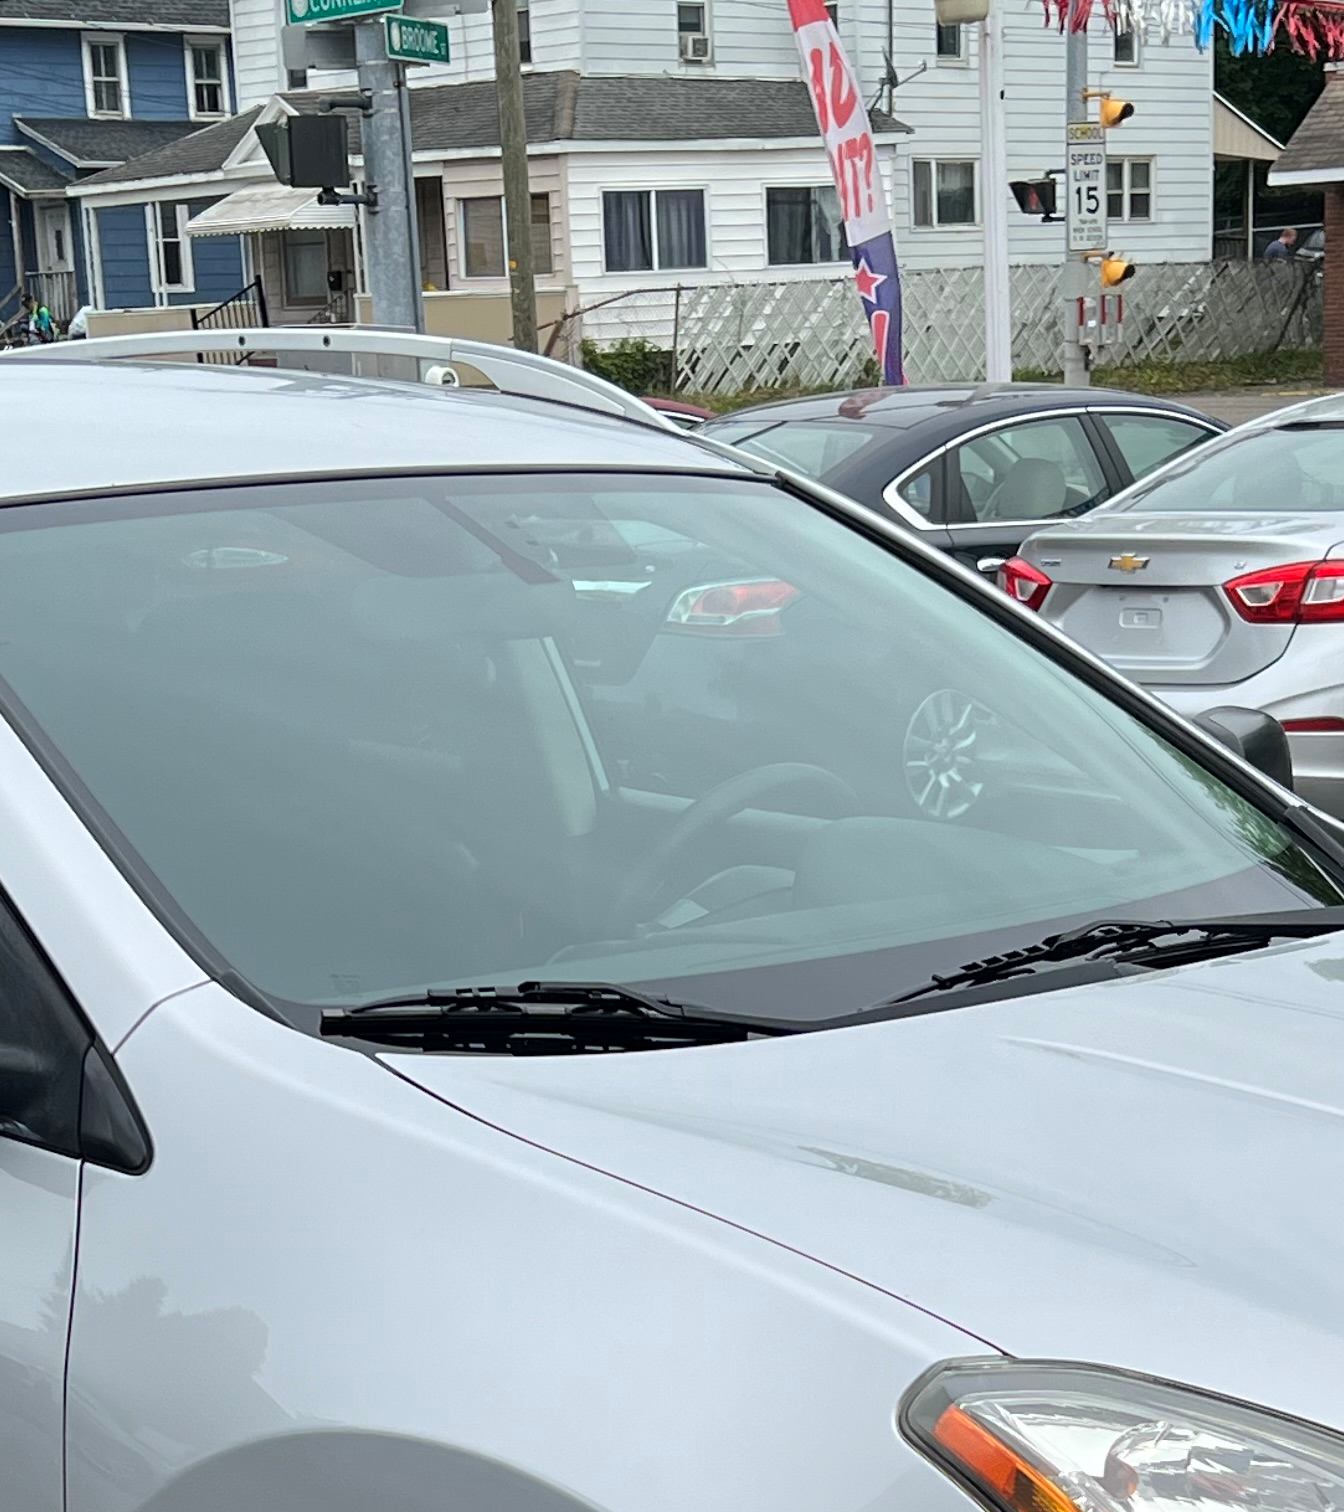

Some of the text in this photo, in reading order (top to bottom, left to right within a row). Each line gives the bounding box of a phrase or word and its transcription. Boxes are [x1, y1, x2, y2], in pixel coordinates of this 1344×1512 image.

[401, 25, 439, 54] BROOME
[1069, 127, 1104, 139] SCHOOL
[1070, 153, 1103, 165] SPEED
[1073, 169, 1099, 181] LIMIT
[1075, 186, 1100, 214] 15
